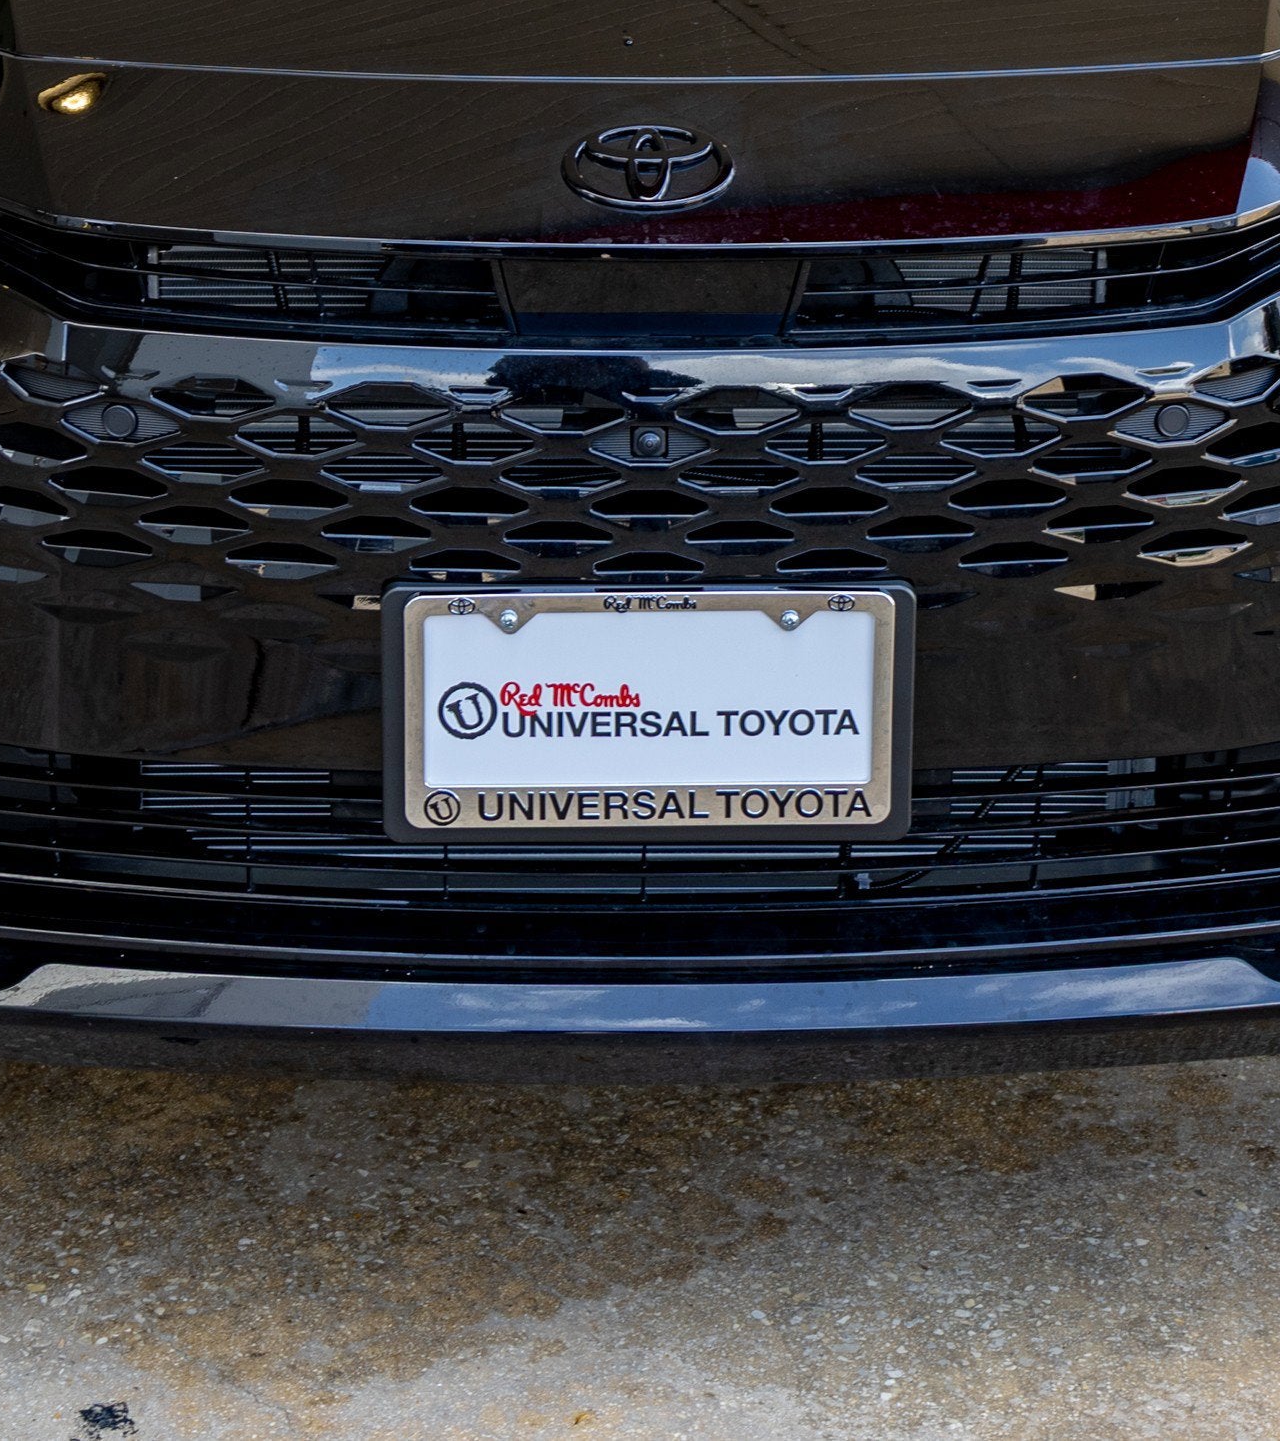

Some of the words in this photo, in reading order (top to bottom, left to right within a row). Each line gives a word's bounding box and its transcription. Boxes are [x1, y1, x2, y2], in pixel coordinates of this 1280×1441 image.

[603, 595, 632, 613] Red
[634, 594, 697, 610] McCombs
[500, 681, 543, 717] Red
[546, 682, 642, 708] McCombs
[501, 711, 710, 738] UNIVERSAL
[716, 708, 861, 737] TOYOTA
[477, 789, 710, 821] UNIVERSAL
[716, 787, 872, 819] TOYOTA
